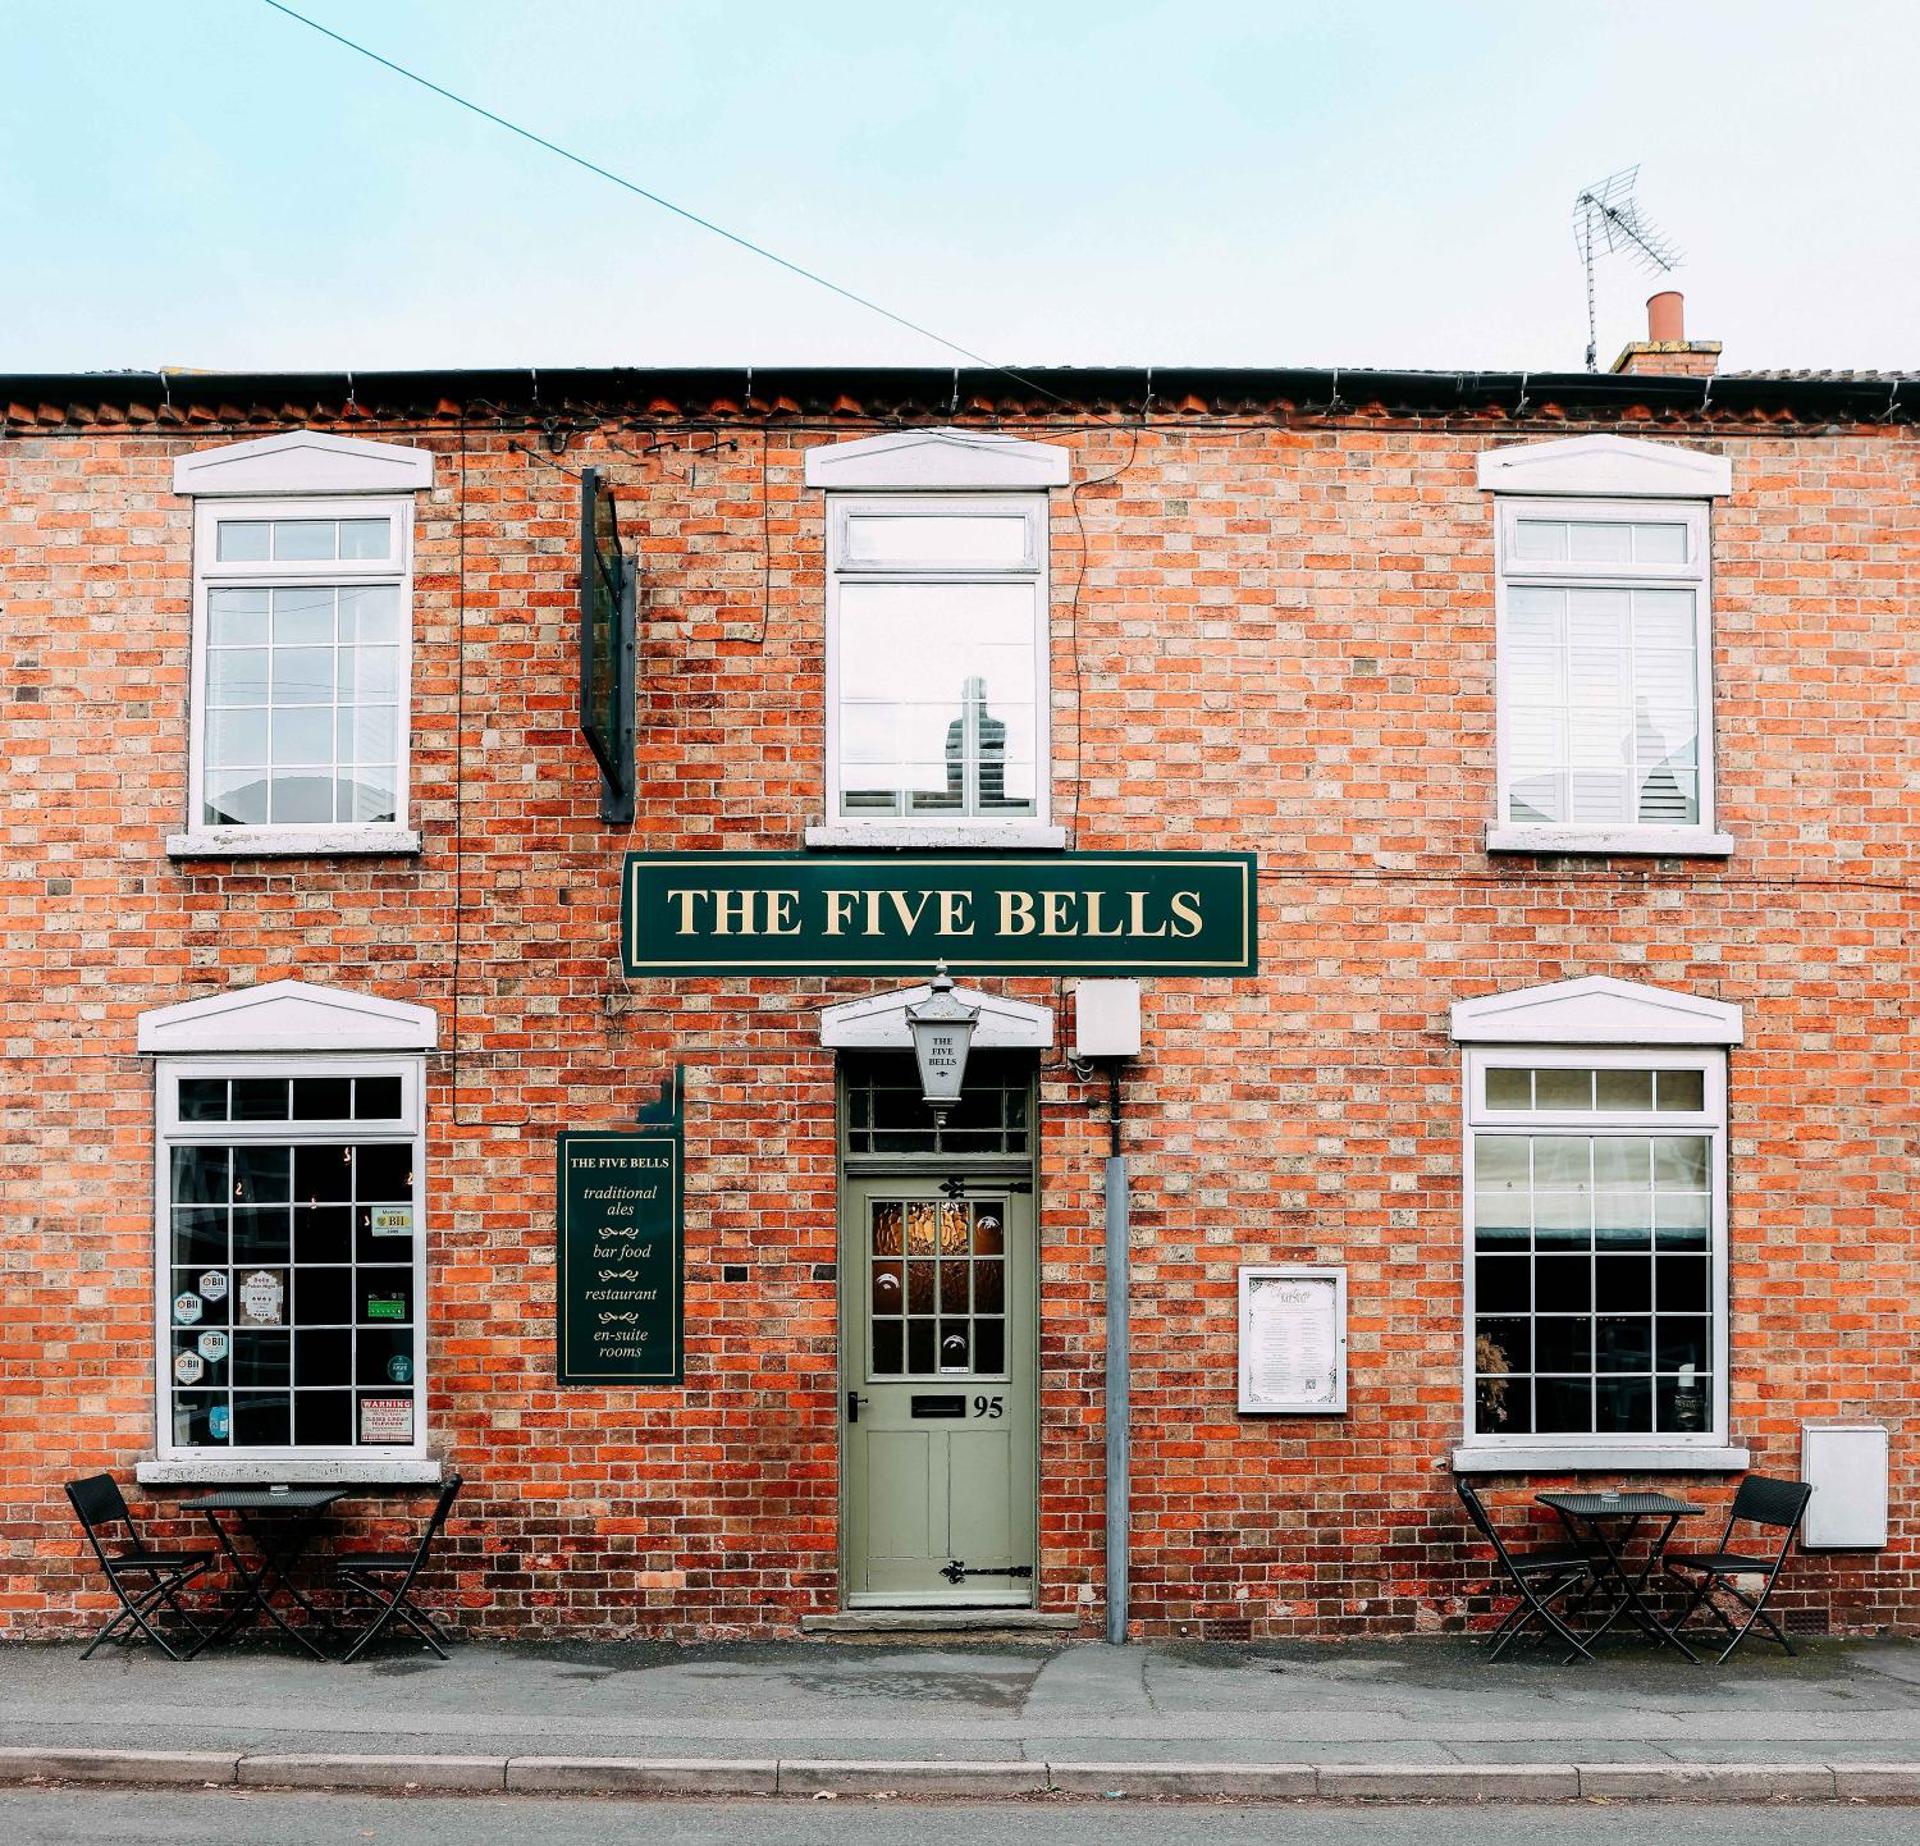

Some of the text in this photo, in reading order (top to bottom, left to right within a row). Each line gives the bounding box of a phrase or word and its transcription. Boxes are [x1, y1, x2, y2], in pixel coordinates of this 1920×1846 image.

[667, 889, 1203, 939] THE FIVE BELLS
[933, 1037, 953, 1045] THE
[932, 1047, 954, 1055] FIVE
[929, 1058, 957, 1066] BELLS
[571, 1158, 669, 1168] THE FIVE BELLS
[583, 1185, 657, 1199] traditional
[607, 1202, 634, 1216] ales
[593, 1244, 651, 1260] bar food
[585, 1288, 657, 1301] restaurant
[593, 1328, 648, 1341] en-suite
[599, 1346, 641, 1358] rooms
[362, 1400, 411, 1408] WARNING
[973, 1395, 1003, 1418] 95
